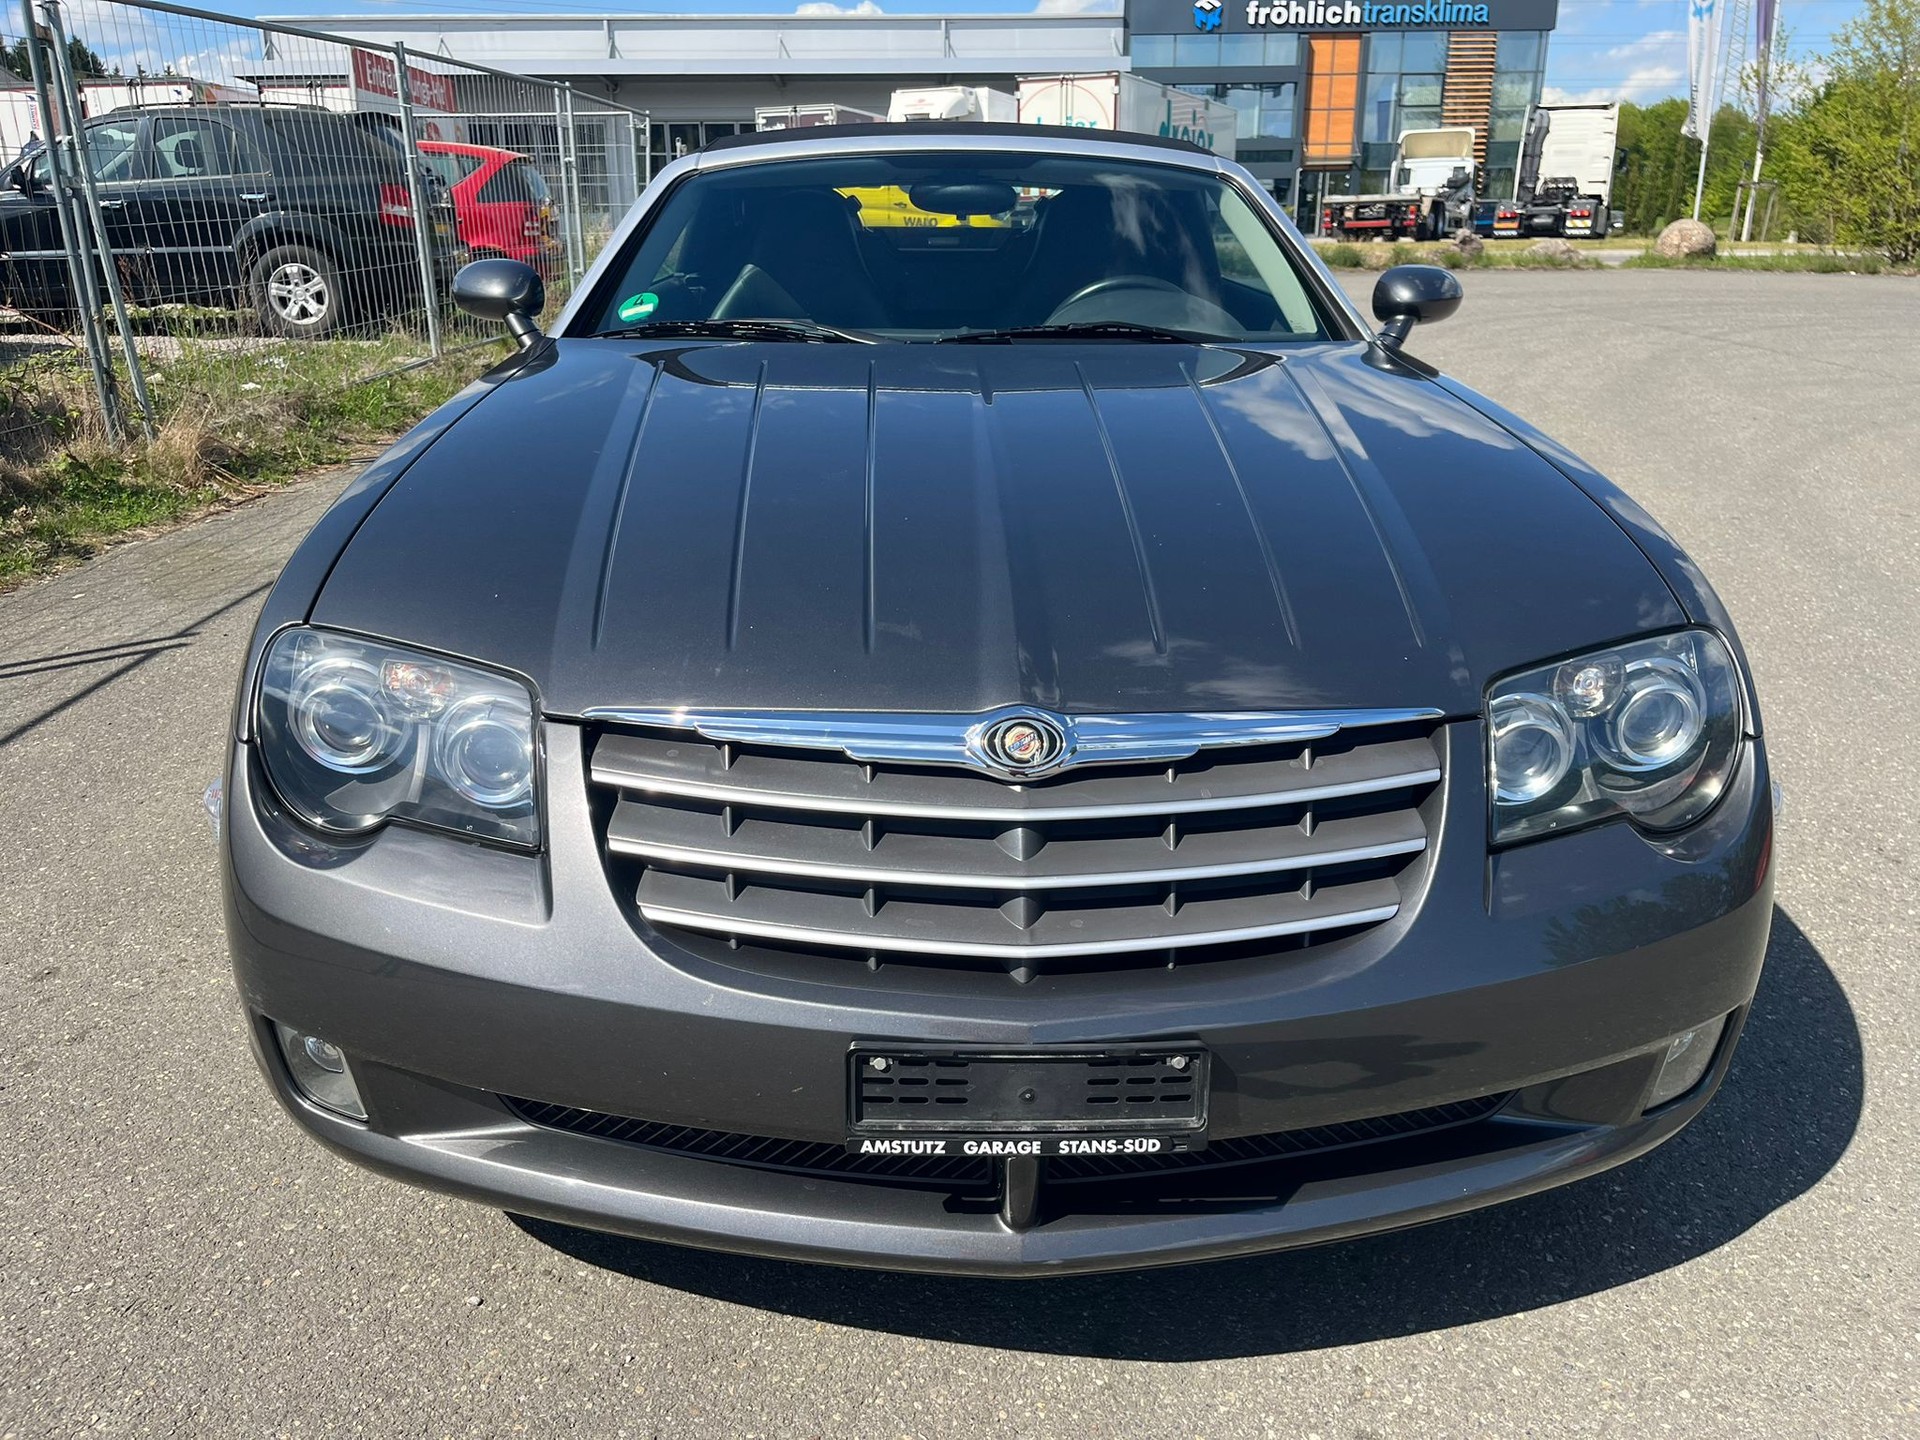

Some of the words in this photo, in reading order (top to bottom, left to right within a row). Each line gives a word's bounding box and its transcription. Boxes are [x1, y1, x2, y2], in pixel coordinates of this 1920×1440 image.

[1246, 0, 1489, 25] fröhlichtransklima
[633, 294, 645, 306] 4
[860, 1140, 946, 1154] AMSTUTZ
[963, 1141, 1041, 1154] GARAGE
[1058, 1137, 1161, 1154] STANS-SÜD
